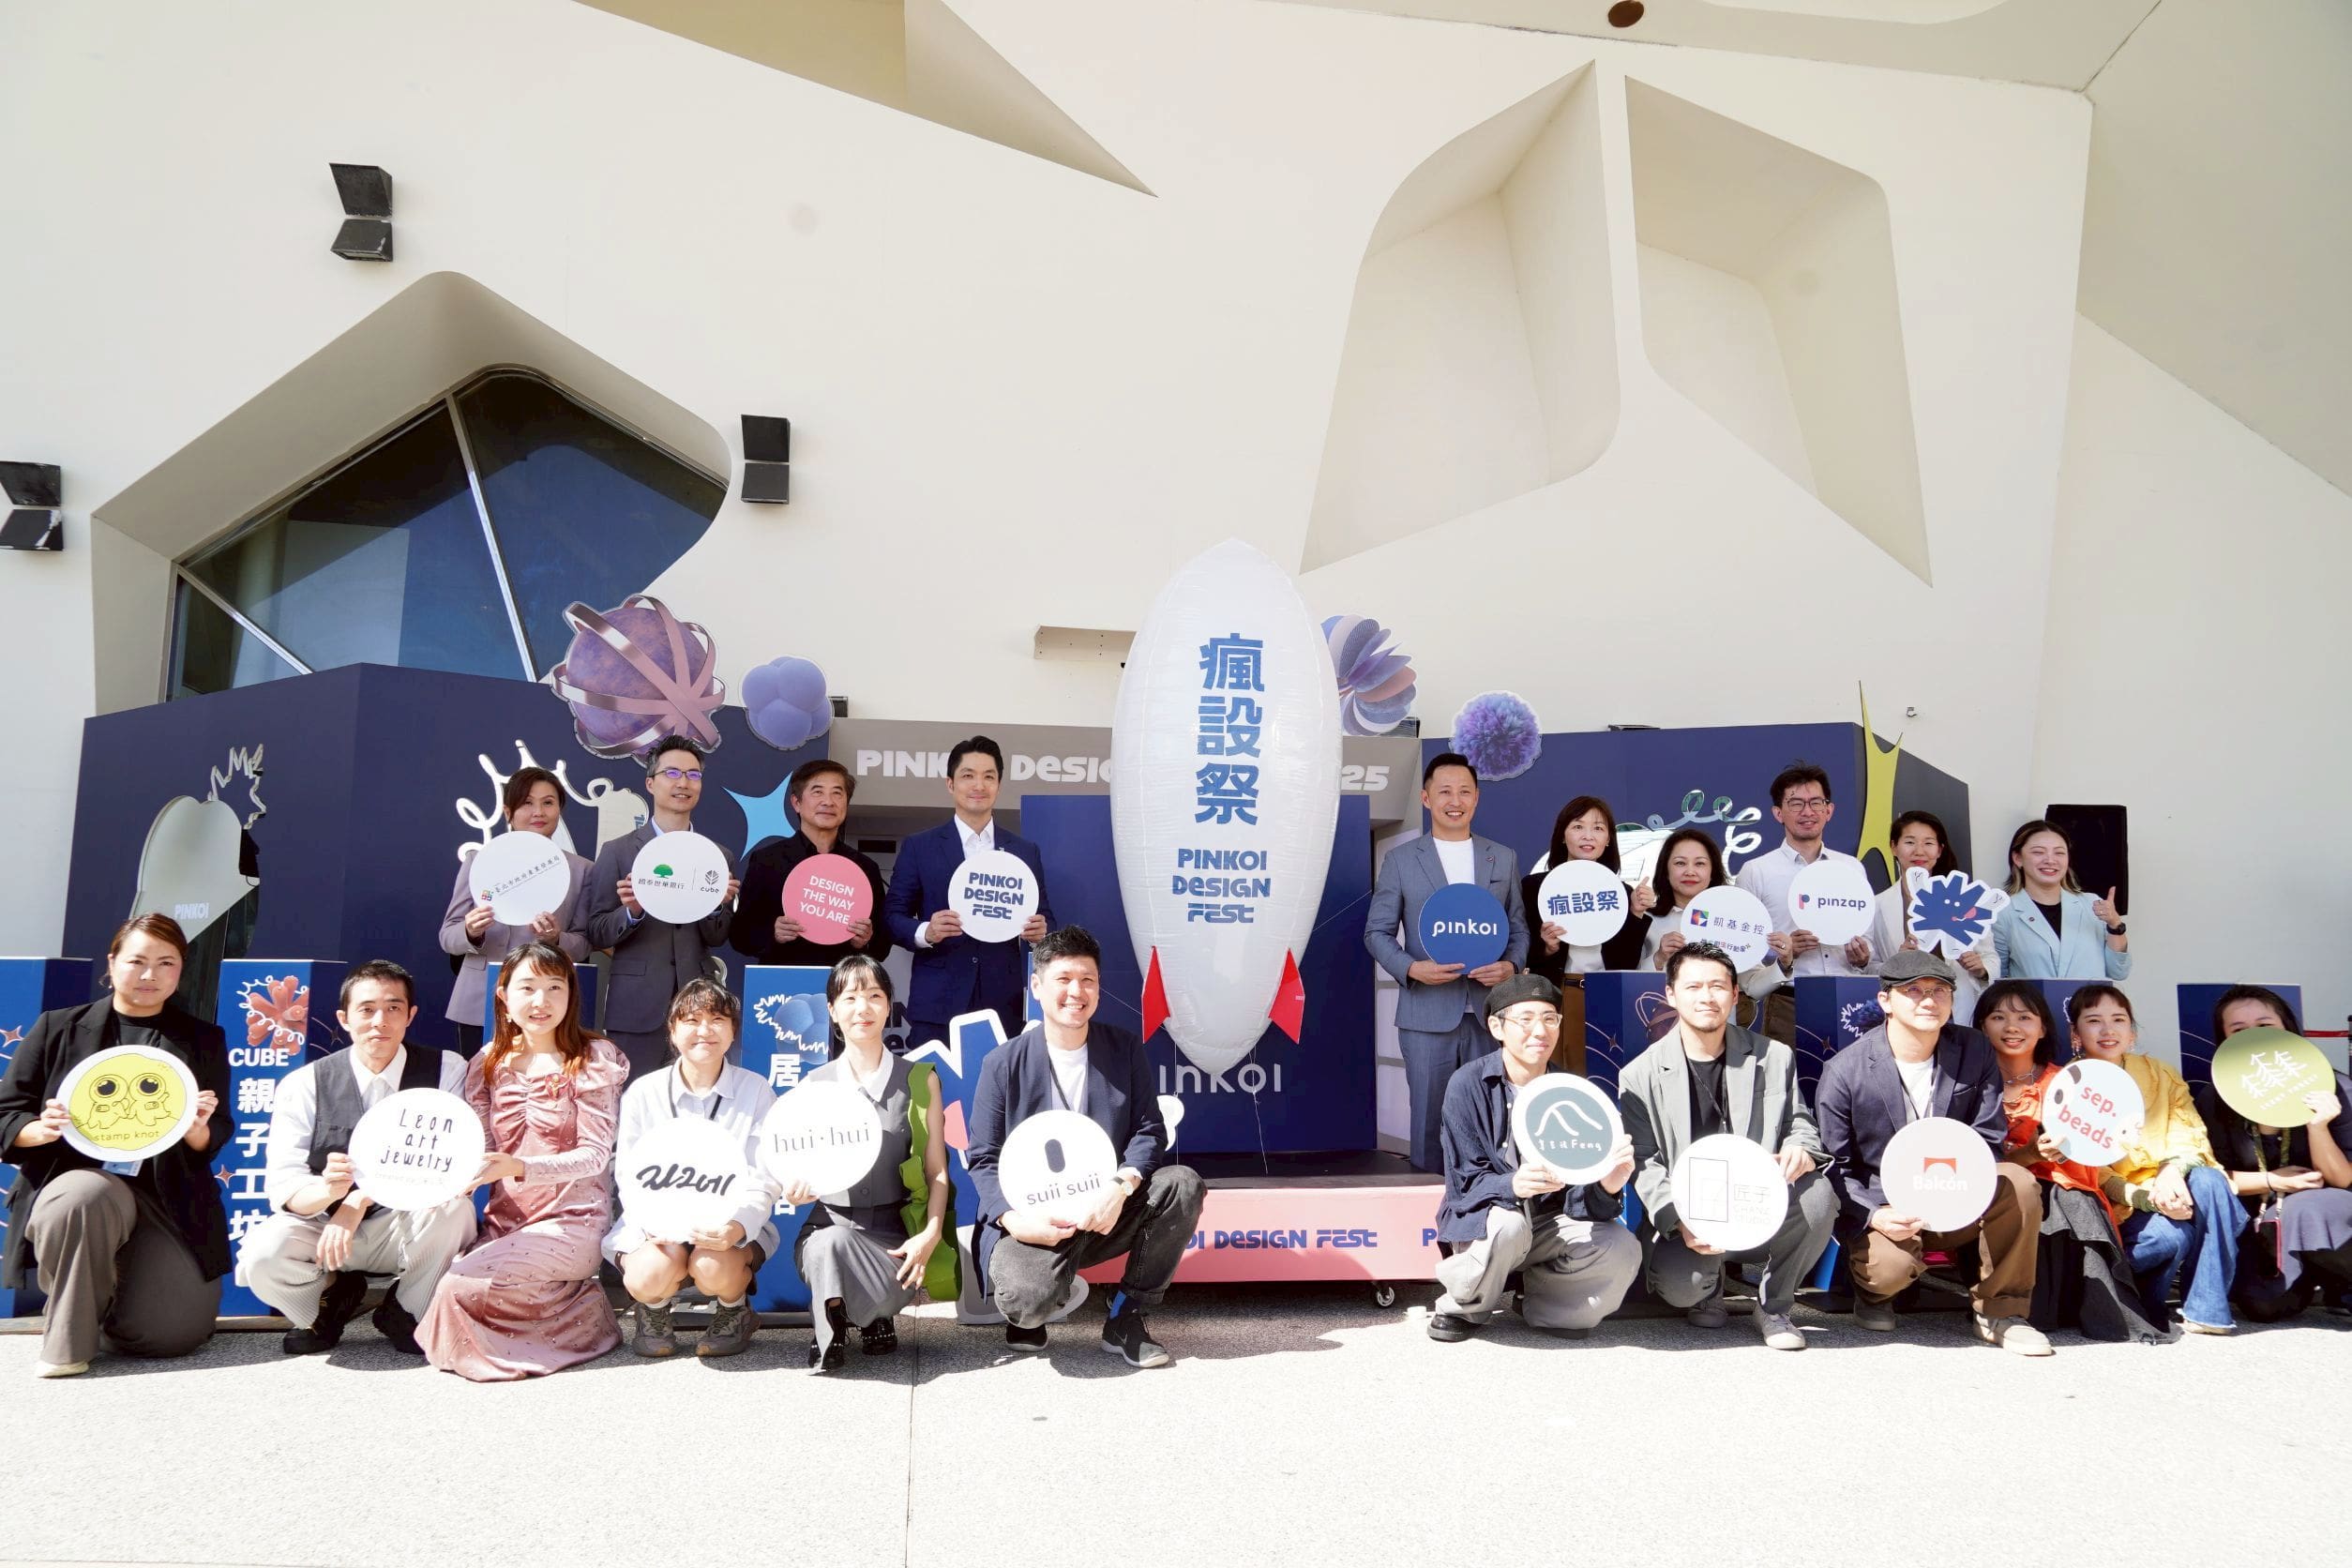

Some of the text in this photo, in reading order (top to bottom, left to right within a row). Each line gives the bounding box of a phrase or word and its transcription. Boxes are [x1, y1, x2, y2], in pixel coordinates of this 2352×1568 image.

[1195, 632, 1265, 825] 瘋設祭
[856, 749, 1390, 792] PINK DESI 25
[1178, 848, 1267, 870] PINKOI
[809, 875, 854, 897] DESIGN
[969, 871, 1023, 891] PINKOI
[803, 887, 855, 911] THE WAY
[1546, 890, 1620, 916] 瘋設祭
[1817, 897, 1866, 912] pinzap
[799, 901, 851, 925] YOU ARE
[1431, 918, 1498, 938] pinkoi
[228, 1048, 290, 1067] CUBE
[1159, 1063, 1282, 1093] inkoi
[2081, 1086, 2117, 1117] sep.
[400, 1108, 453, 1133] Leon
[2058, 1104, 2114, 1149] beads
[94, 1129, 160, 1142] stamp knot
[405, 1134, 438, 1150] art
[381, 1146, 453, 1172] jewelry
[1026, 1172, 1100, 1205] suii suii
